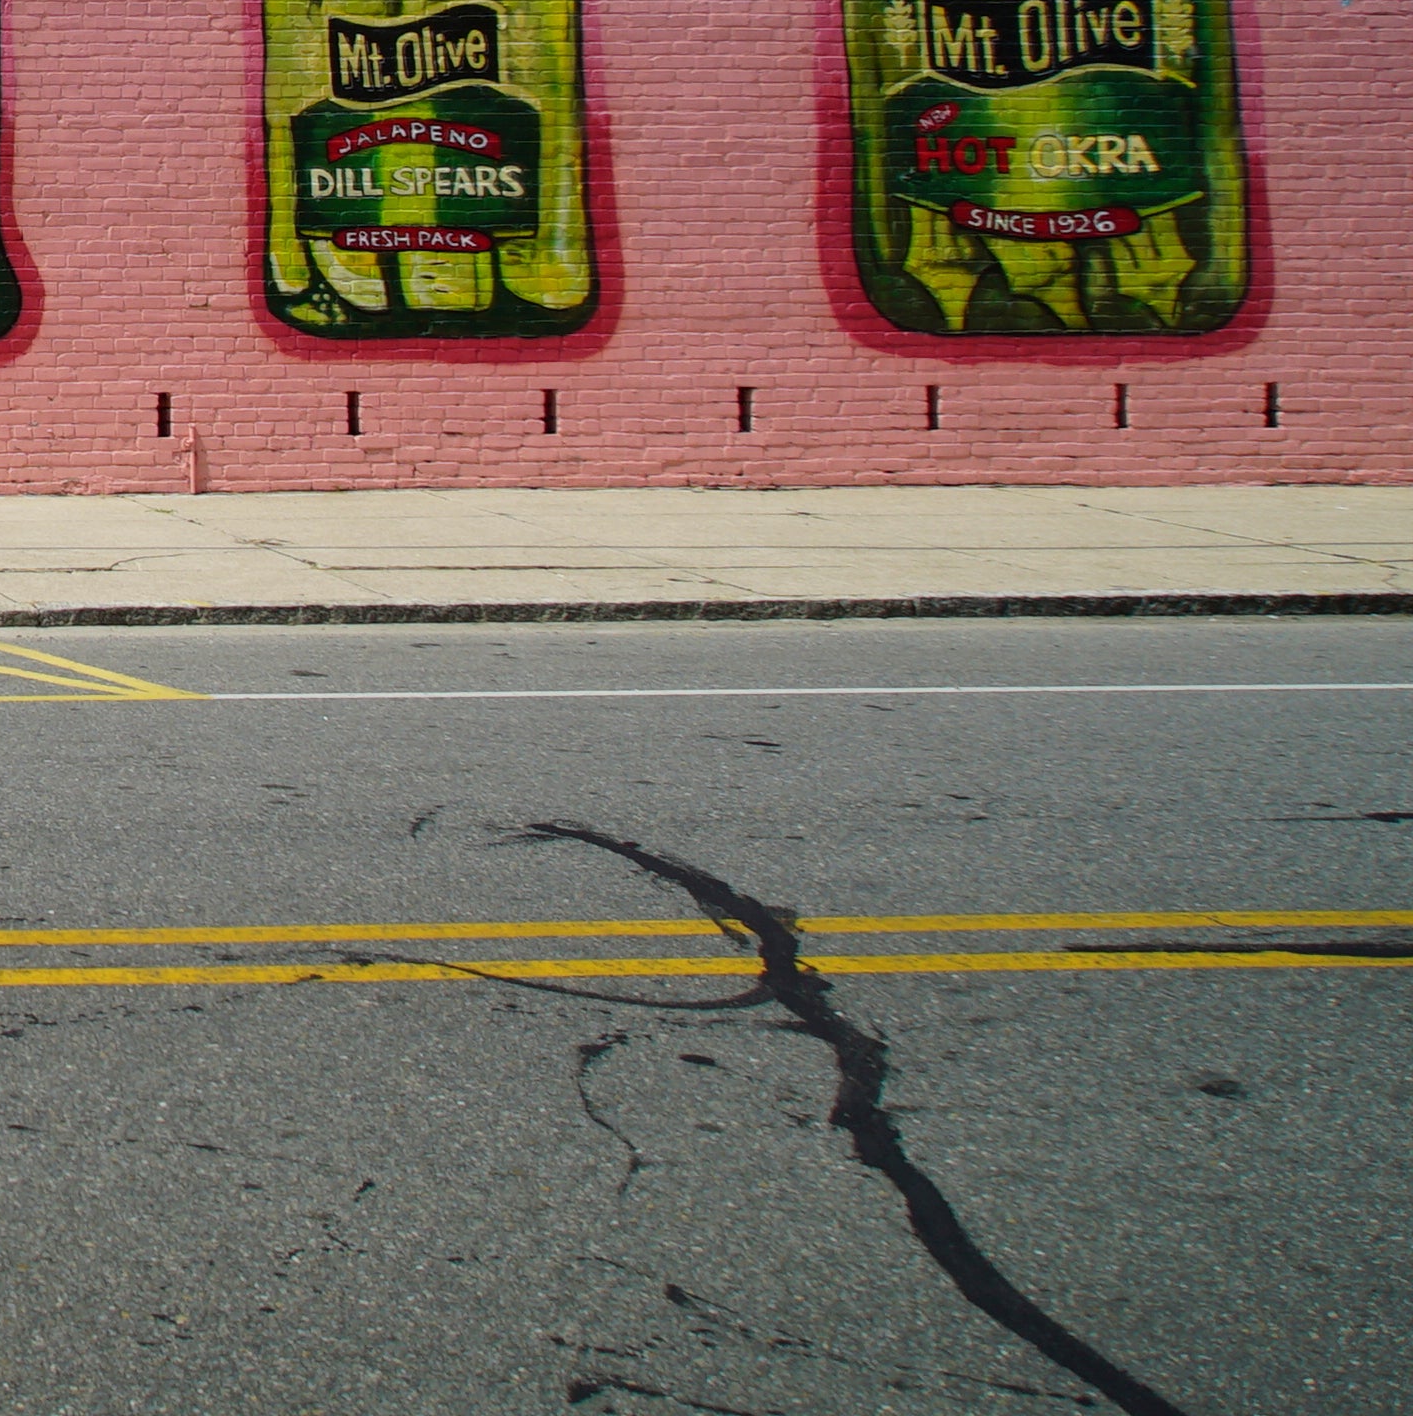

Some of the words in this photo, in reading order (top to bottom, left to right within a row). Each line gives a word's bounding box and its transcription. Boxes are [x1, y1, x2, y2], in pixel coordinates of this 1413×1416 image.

[932, 4, 1009, 76] Mt.
[338, 32, 391, 88] Mt.
[396, 26, 487, 87] Olive
[339, 122, 489, 153] JALAPENO
[914, 136, 1016, 175] HOT
[1030, 134, 1162, 178] OKRA
[310, 168, 384, 199] DILL
[390, 166, 524, 198] SPEARS
[968, 209, 1035, 235] SINCE
[1049, 211, 1117, 235] 1926
[346, 230, 410, 247] FRESH
[419, 230, 477, 248] PACK
